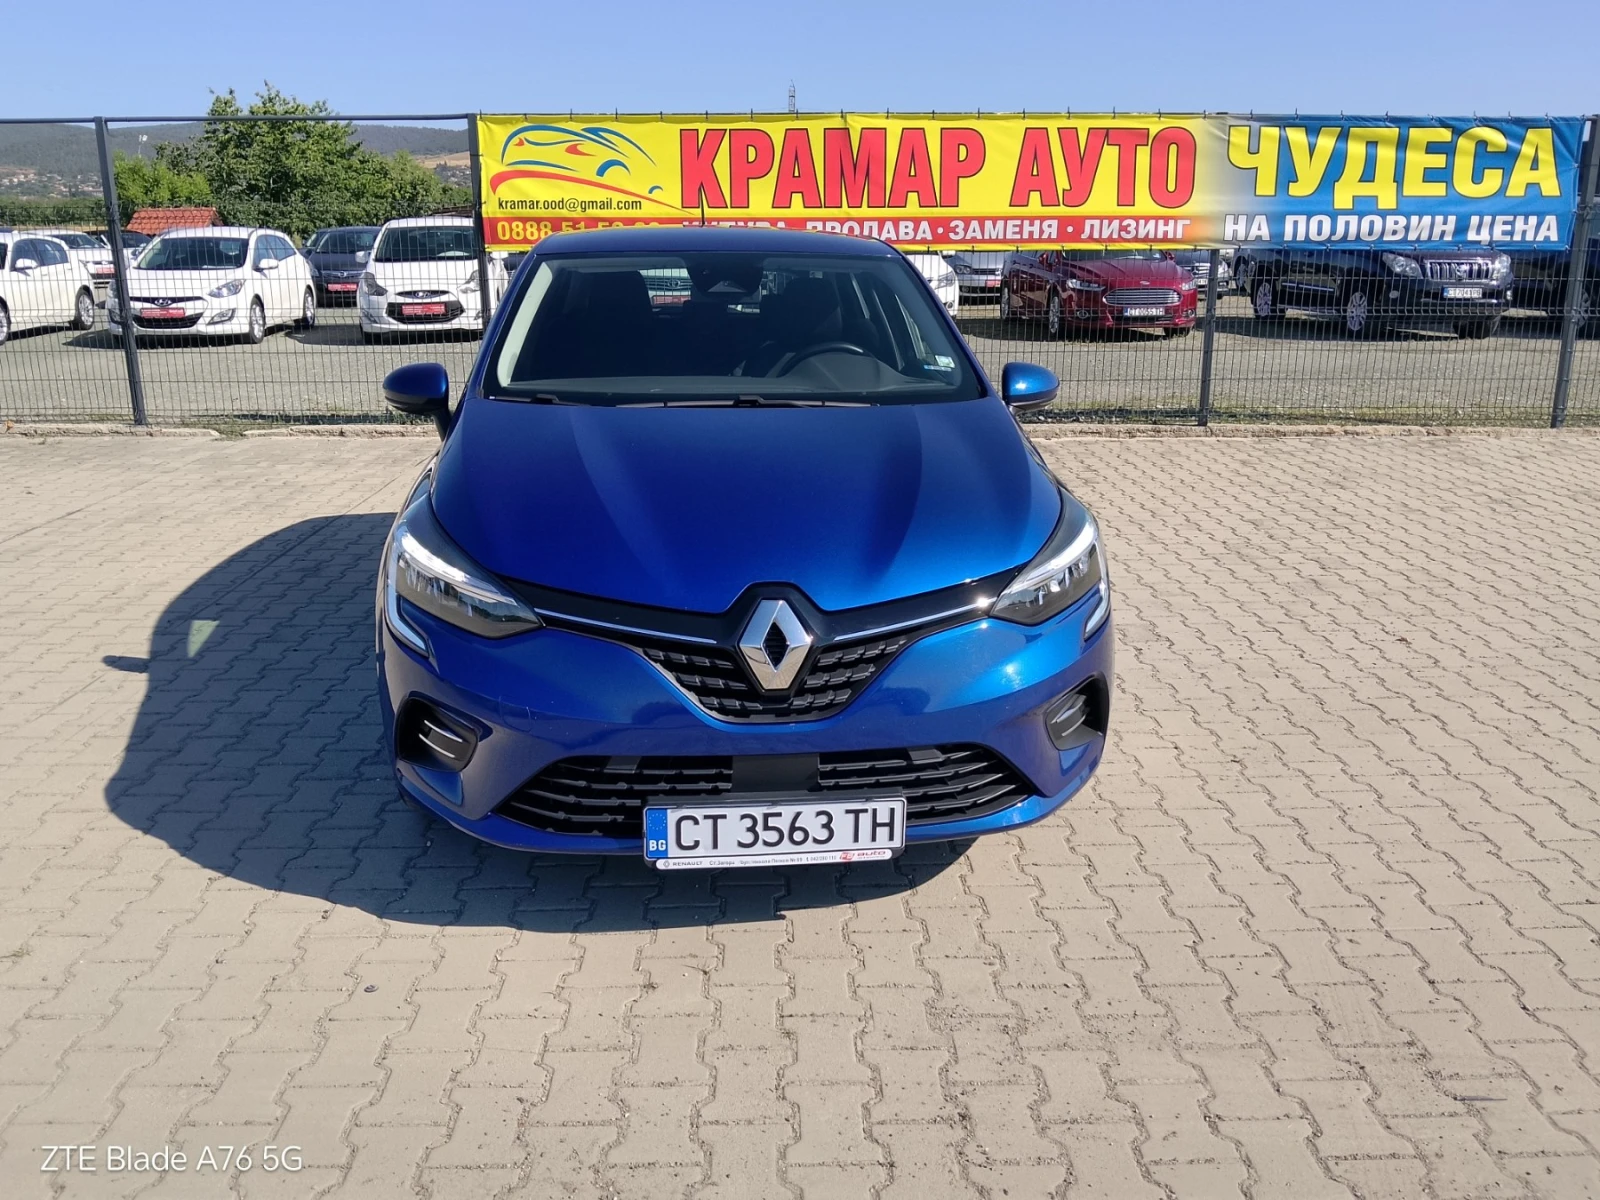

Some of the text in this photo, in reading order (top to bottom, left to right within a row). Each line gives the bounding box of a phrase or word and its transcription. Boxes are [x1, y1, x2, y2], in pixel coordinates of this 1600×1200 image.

[679, 126, 1197, 209] КРАМАР АУТО
[1227, 125, 1561, 210] ЧУДЕСА
[497, 197, 642, 213] kramar.ood@gmail.com
[496, 221, 553, 240] 0888
[948, 219, 1058, 240] ЗАМЕНЯ
[1080, 218, 1190, 239] ЛИЗИНГ
[1224, 214, 1559, 245] НА ПОЛОВИН ЦЕНА
[675, 807, 895, 851] CT 3563 TH
[649, 840, 667, 851] BG
